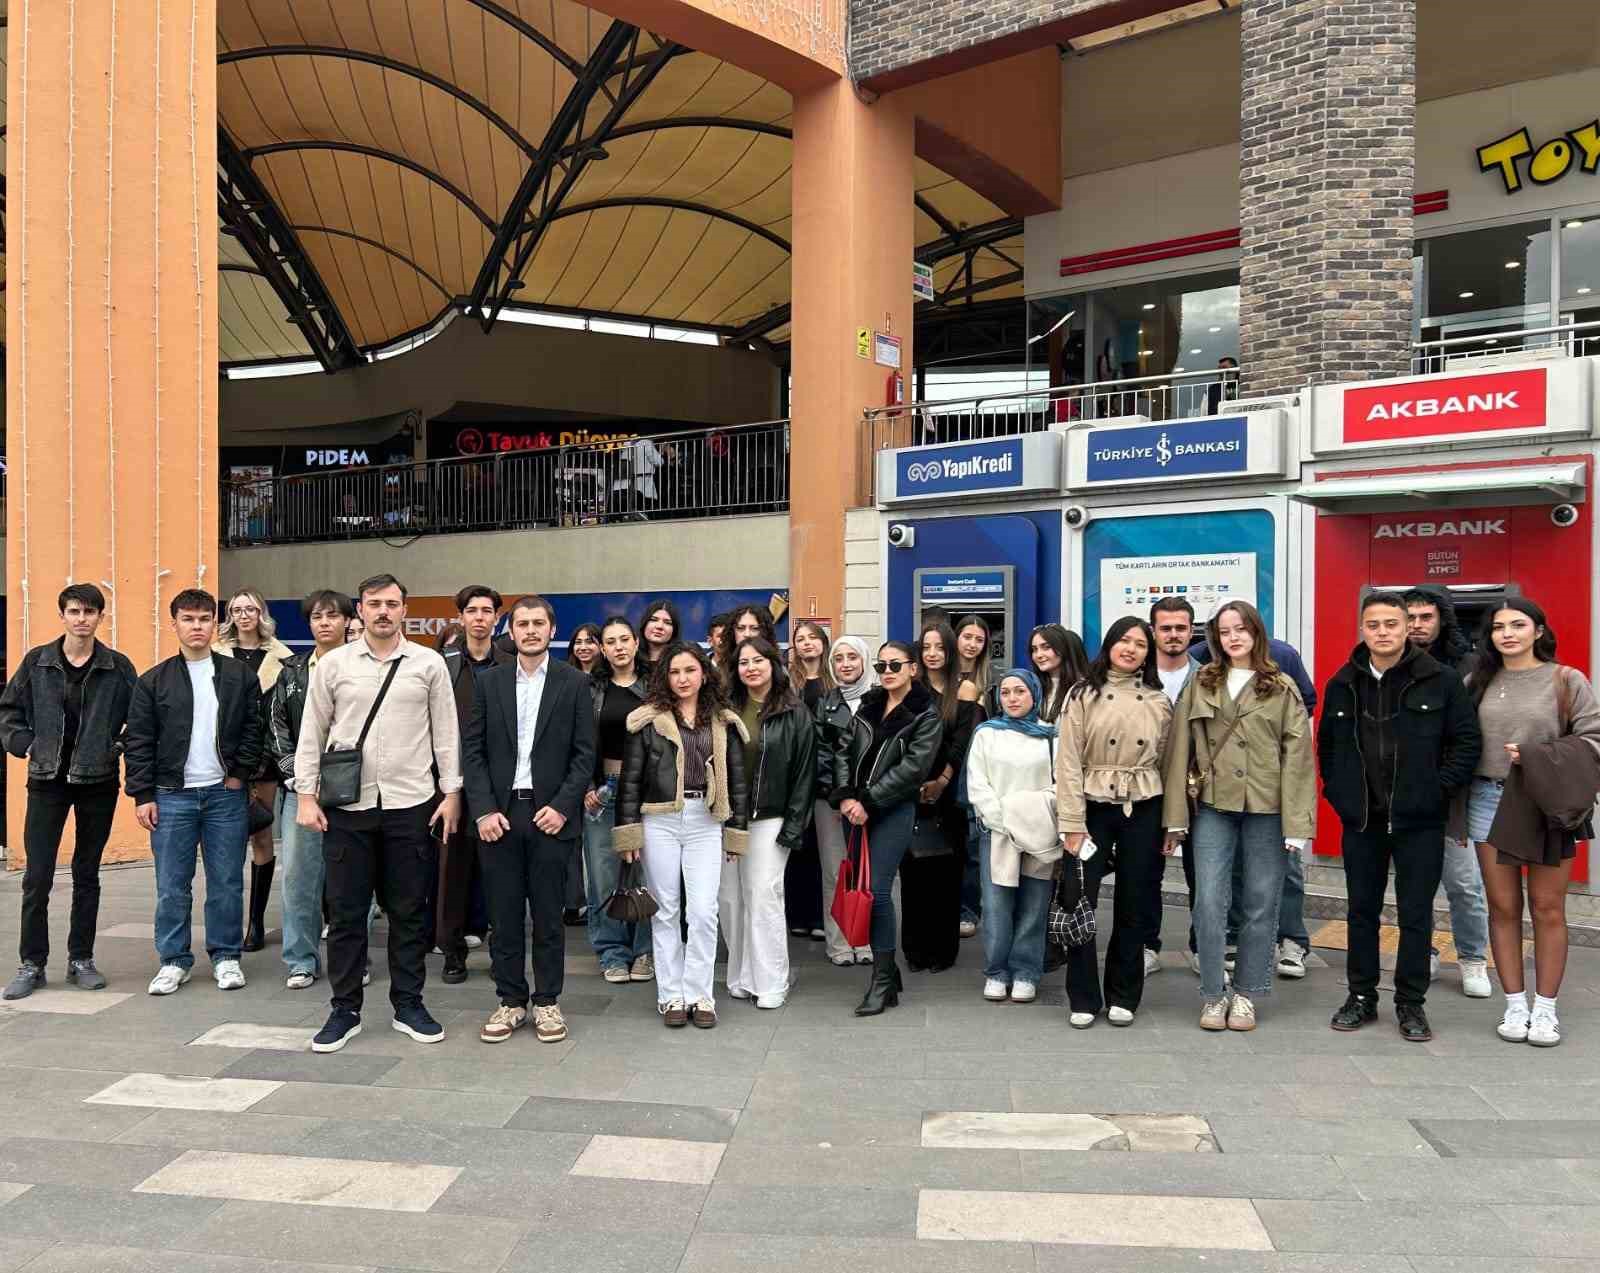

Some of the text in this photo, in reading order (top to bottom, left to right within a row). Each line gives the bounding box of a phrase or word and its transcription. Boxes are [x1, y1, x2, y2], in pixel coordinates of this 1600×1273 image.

[1366, 390, 1521, 422] AKBANK
[487, 431, 552, 450] Tavuk
[1094, 446, 1153, 462] TÜRKİYE
[1175, 440, 1240, 456] BANKASI
[1374, 519, 1506, 539] AKBANK
